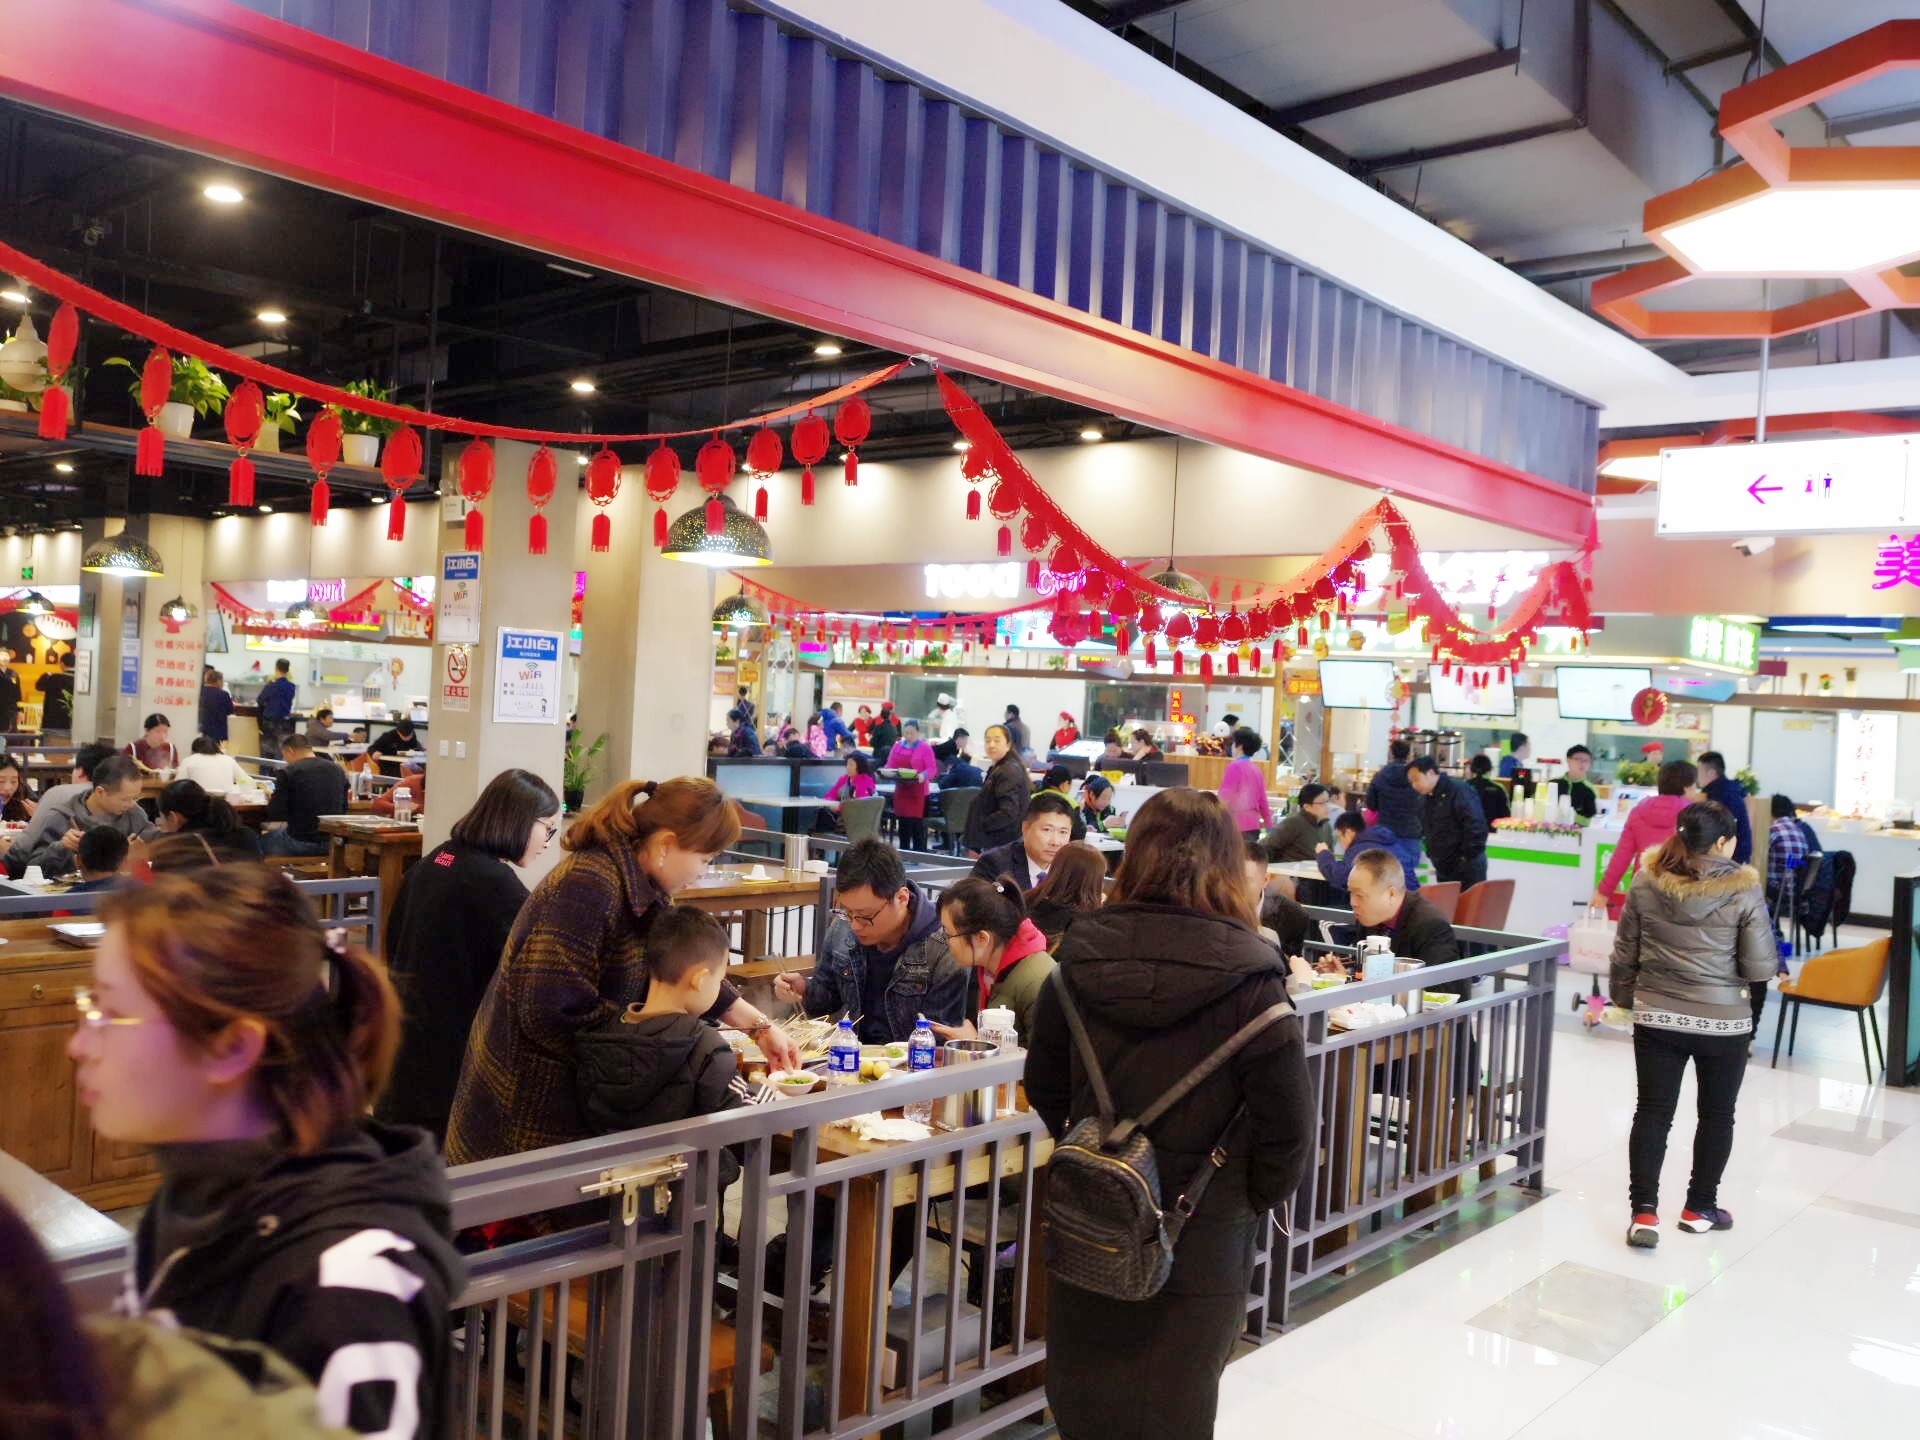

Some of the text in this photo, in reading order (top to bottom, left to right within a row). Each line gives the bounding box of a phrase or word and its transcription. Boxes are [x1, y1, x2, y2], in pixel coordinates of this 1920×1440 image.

[447, 557, 475, 571] 江小白
[506, 635, 553, 651] 江小白
